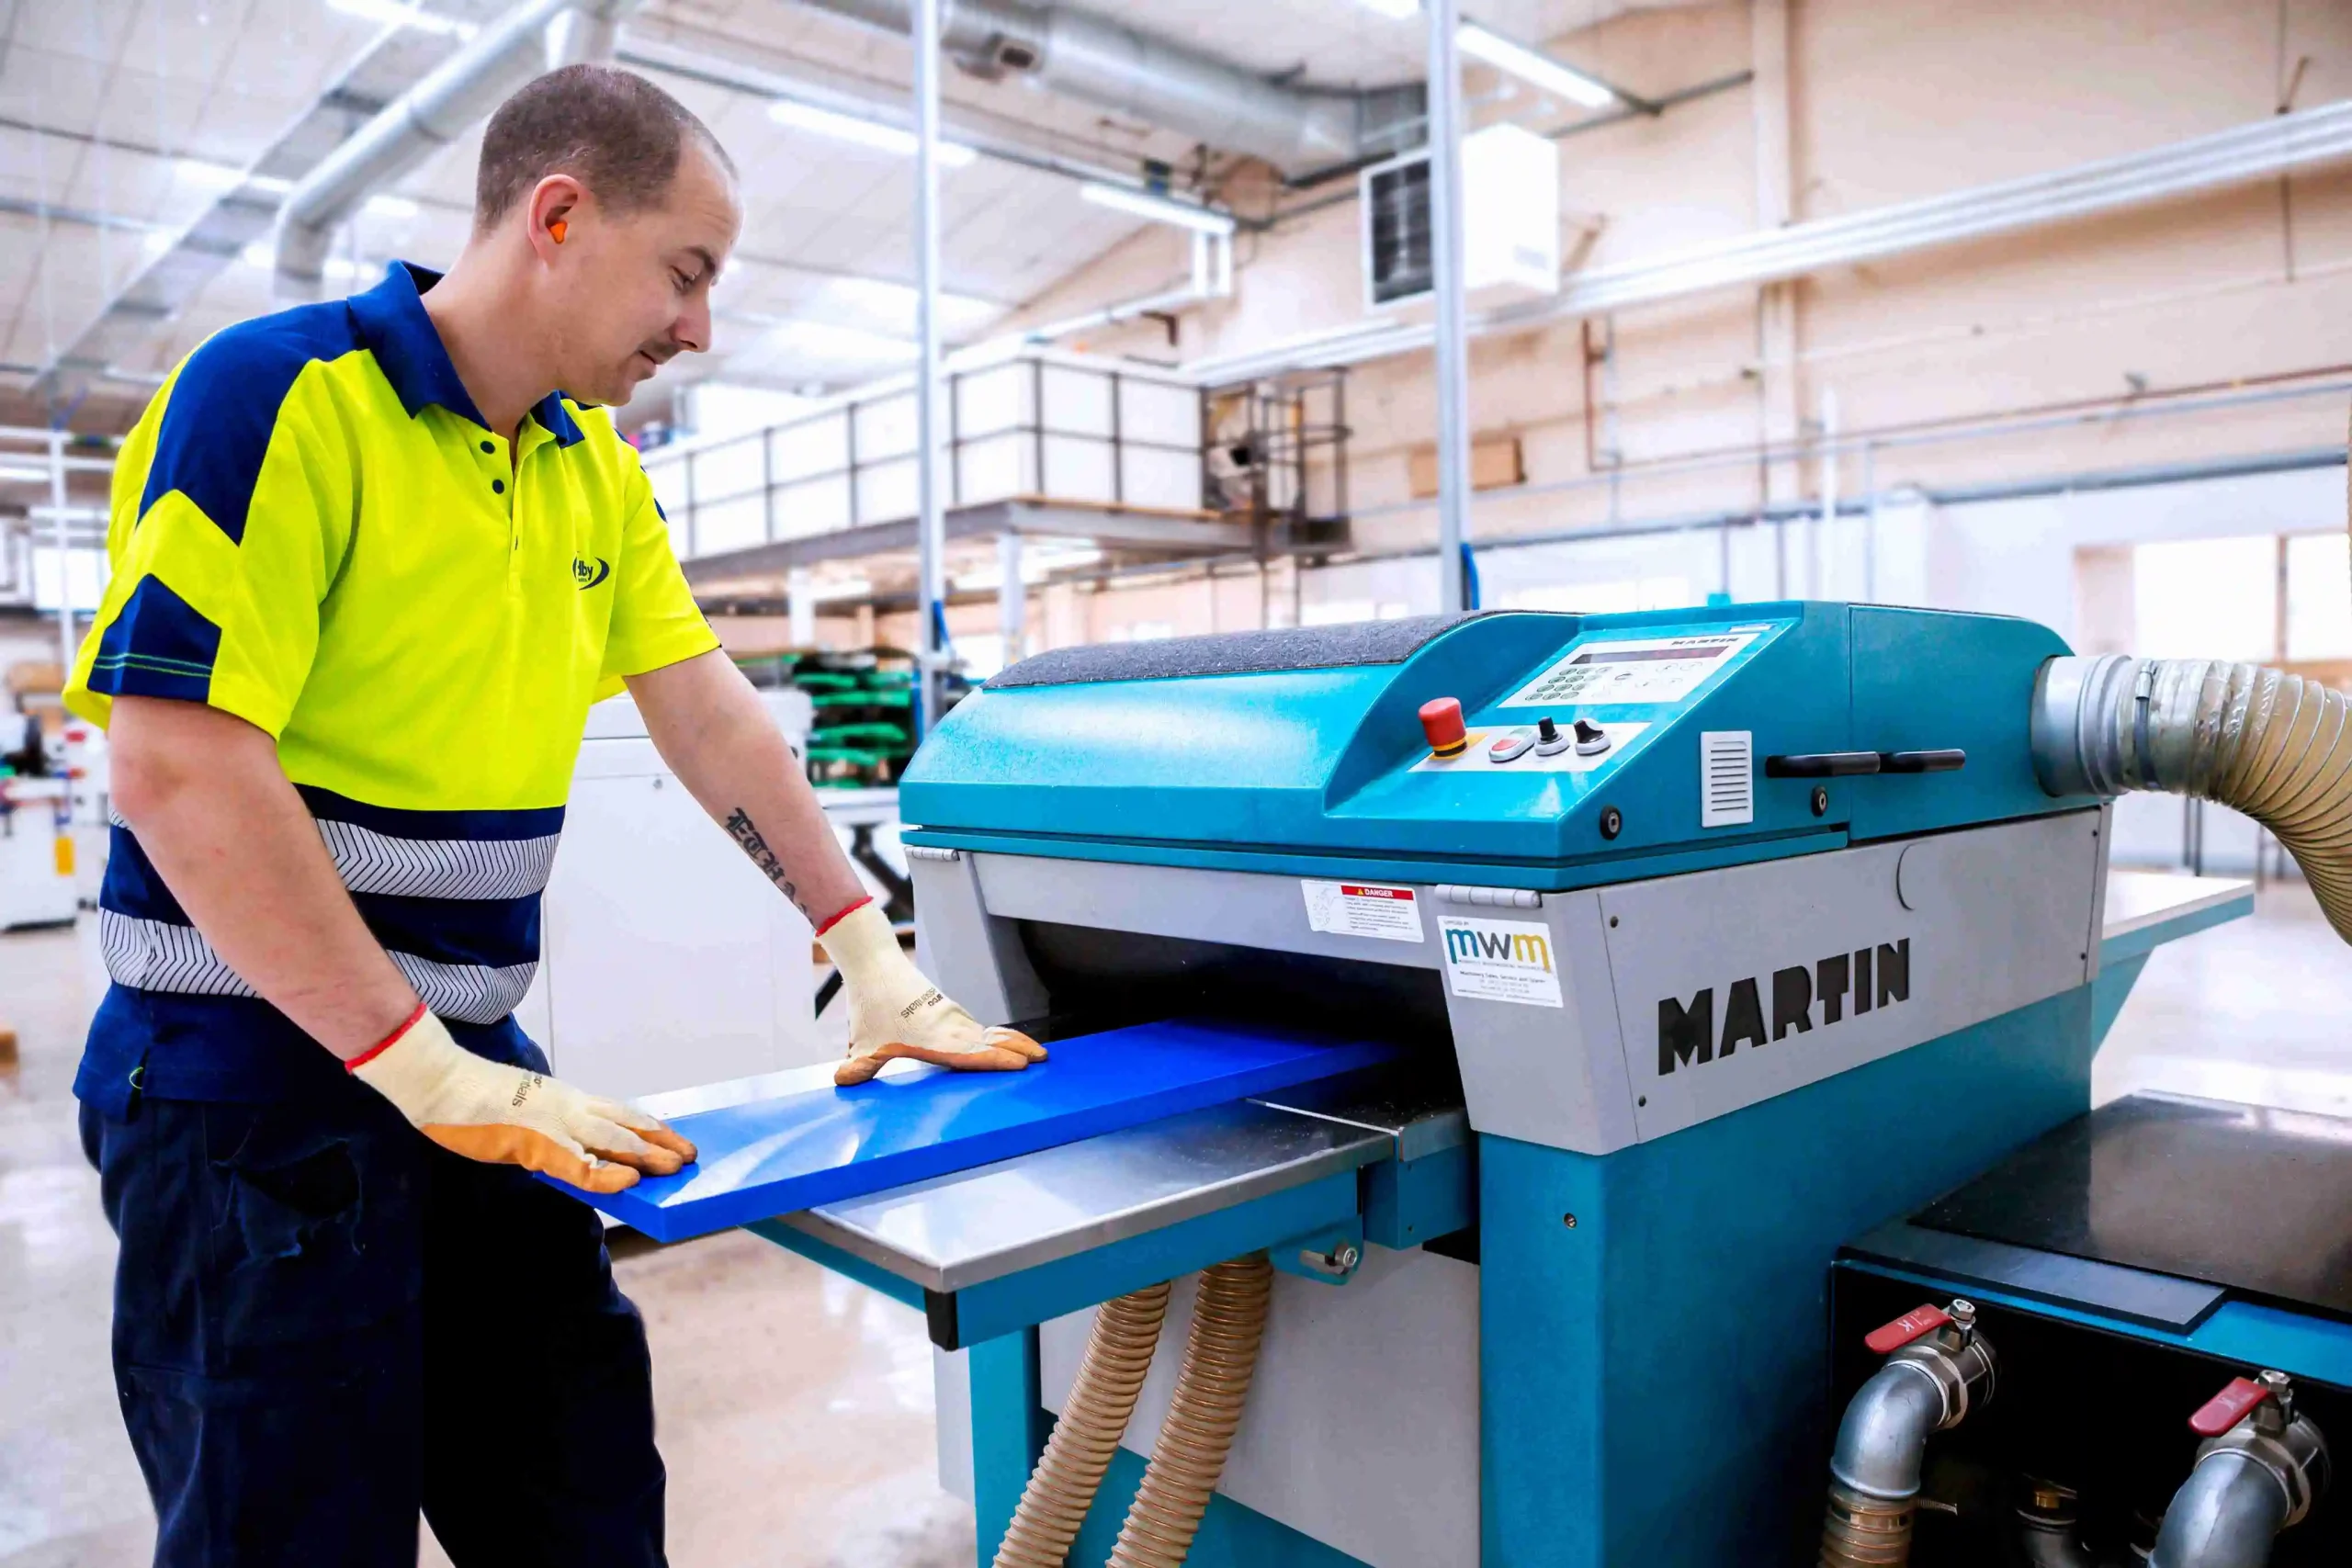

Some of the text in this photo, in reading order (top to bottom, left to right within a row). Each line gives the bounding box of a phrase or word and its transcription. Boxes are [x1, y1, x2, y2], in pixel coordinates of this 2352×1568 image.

[1364, 888, 1394, 897] DANGER
[1445, 928, 1552, 974] mwm
[1658, 938, 1910, 1076] MARTIN
